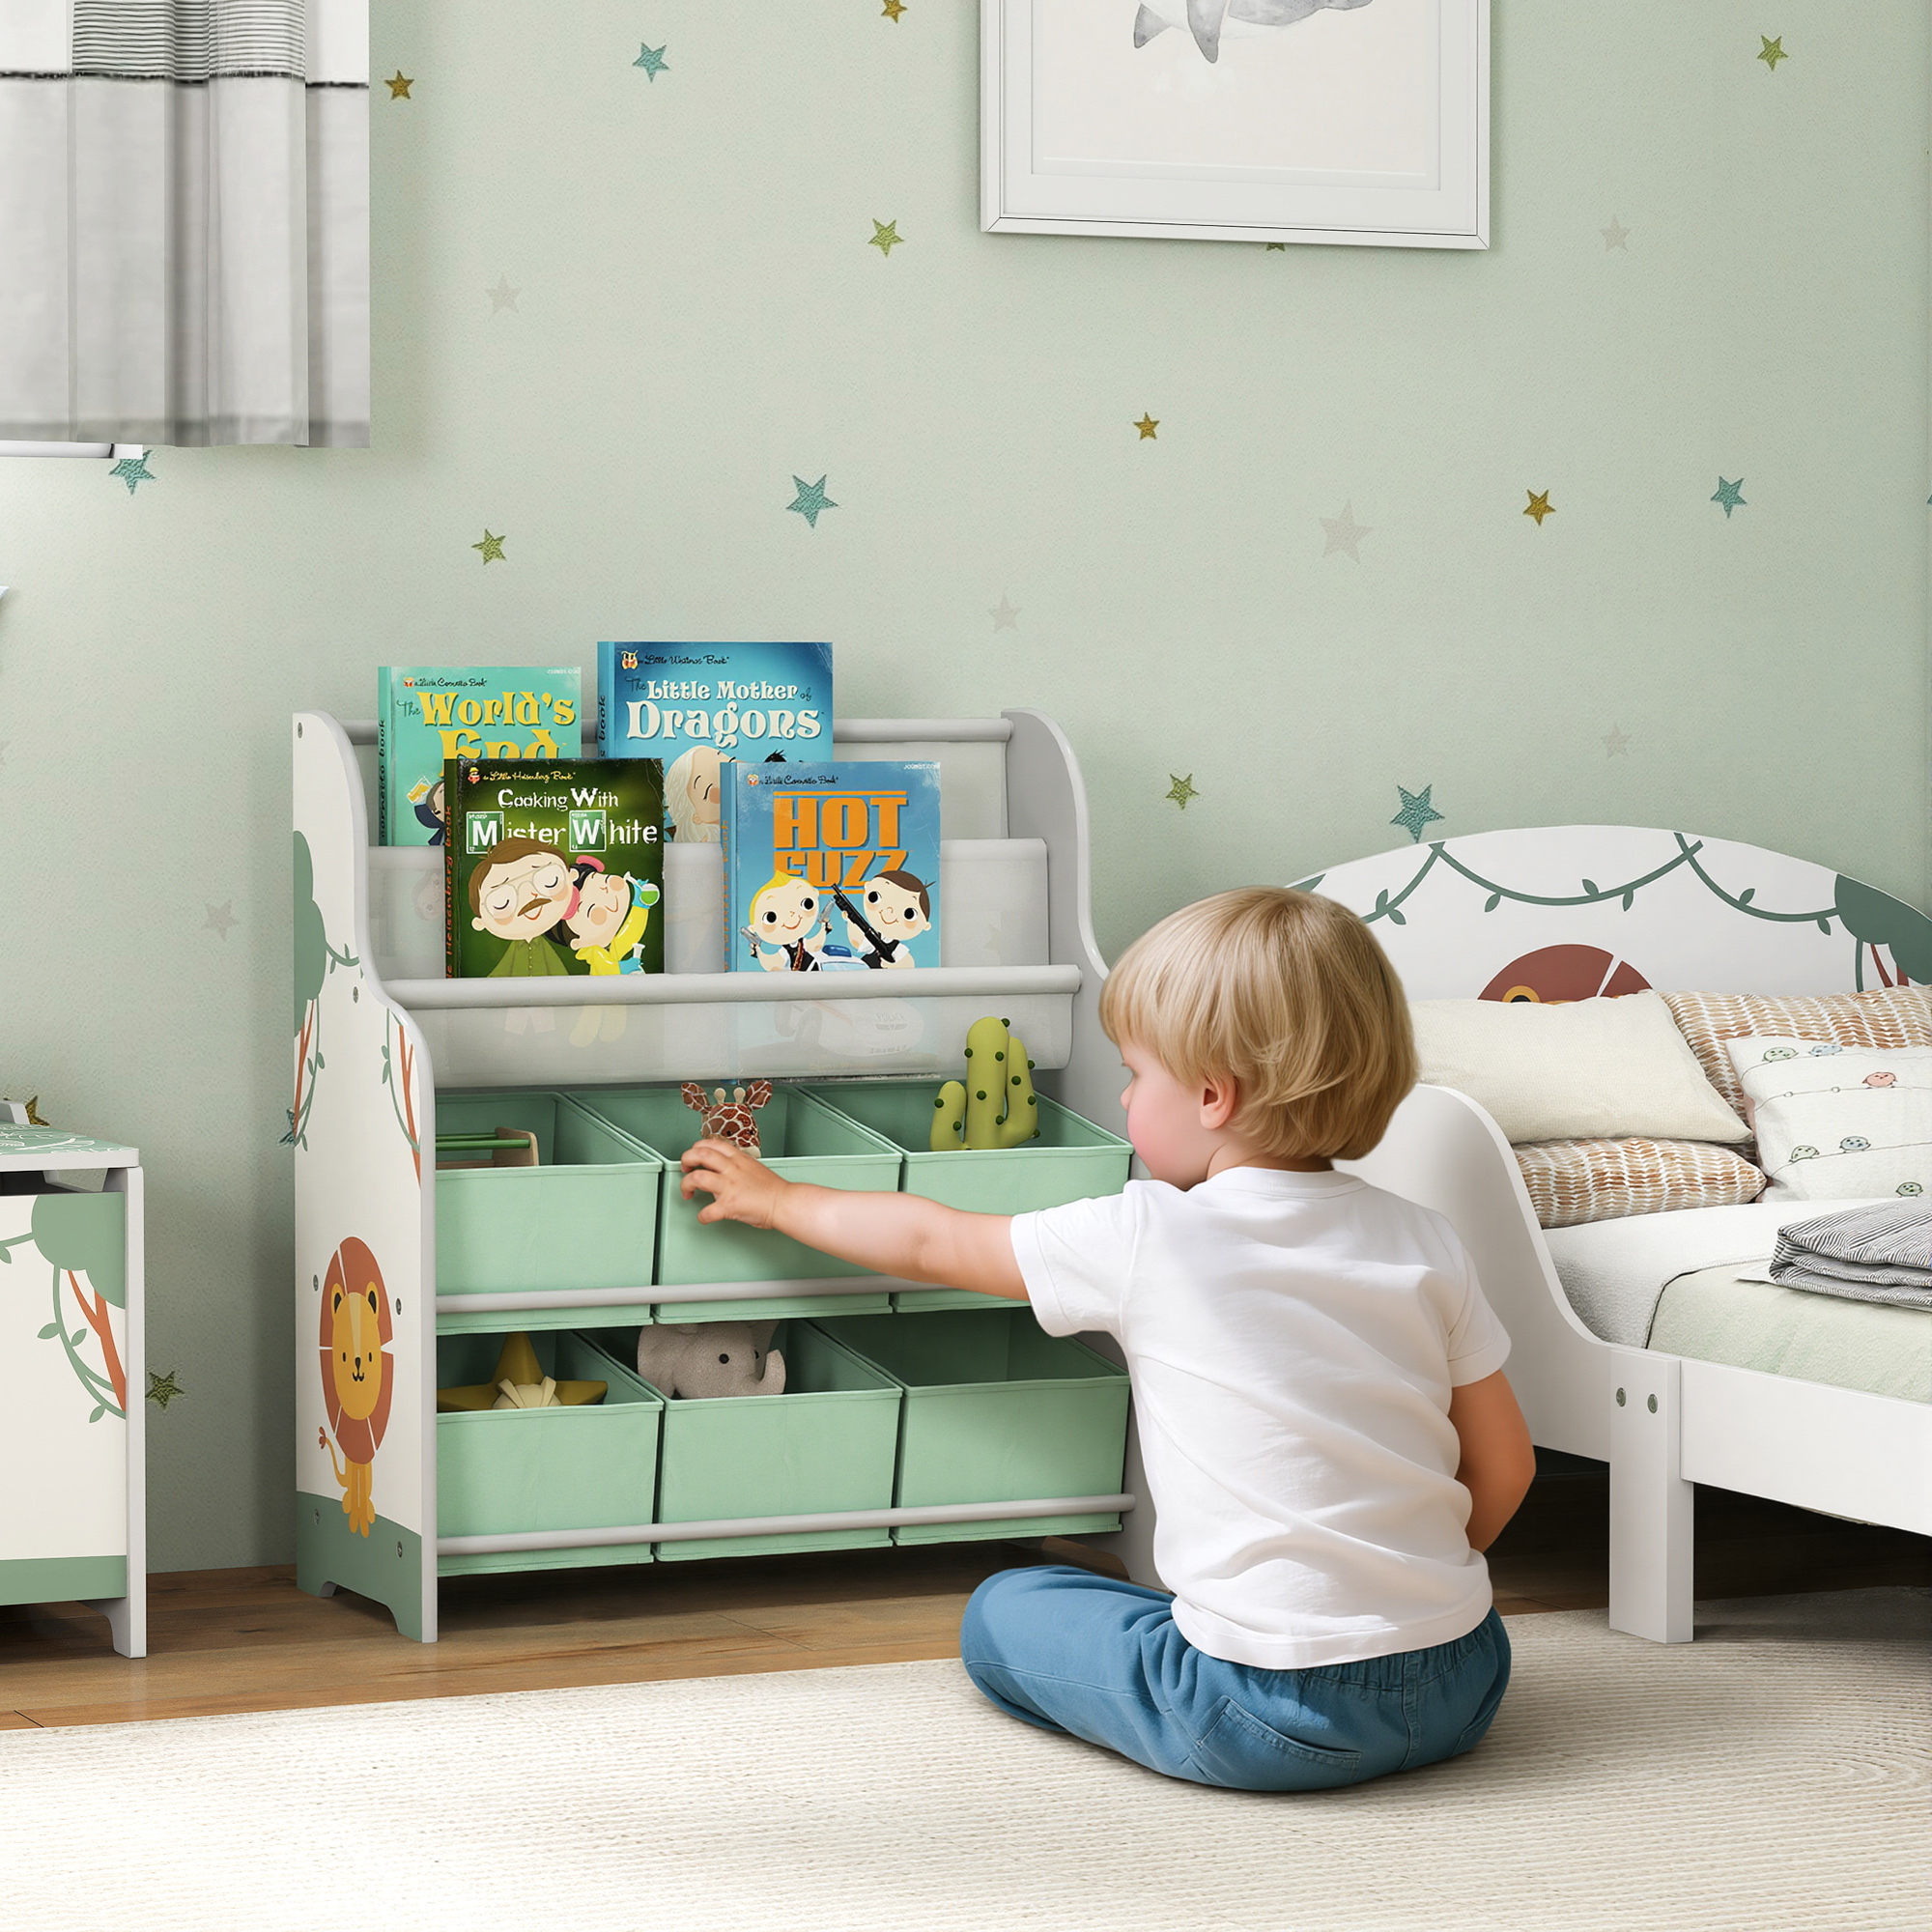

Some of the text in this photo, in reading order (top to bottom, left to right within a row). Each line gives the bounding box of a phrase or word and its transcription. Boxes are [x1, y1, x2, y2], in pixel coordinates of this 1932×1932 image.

[625, 677, 811, 702] The Little Mother of
[396, 692, 576, 726] The World's
[598, 695, 607, 741] book
[626, 700, 822, 749] Dragons
[497, 786, 619, 811] Cooking With
[472, 820, 567, 846] Mister
[572, 819, 658, 845] White
[774, 797, 907, 848] HOT
[774, 851, 907, 888] FUZZ
